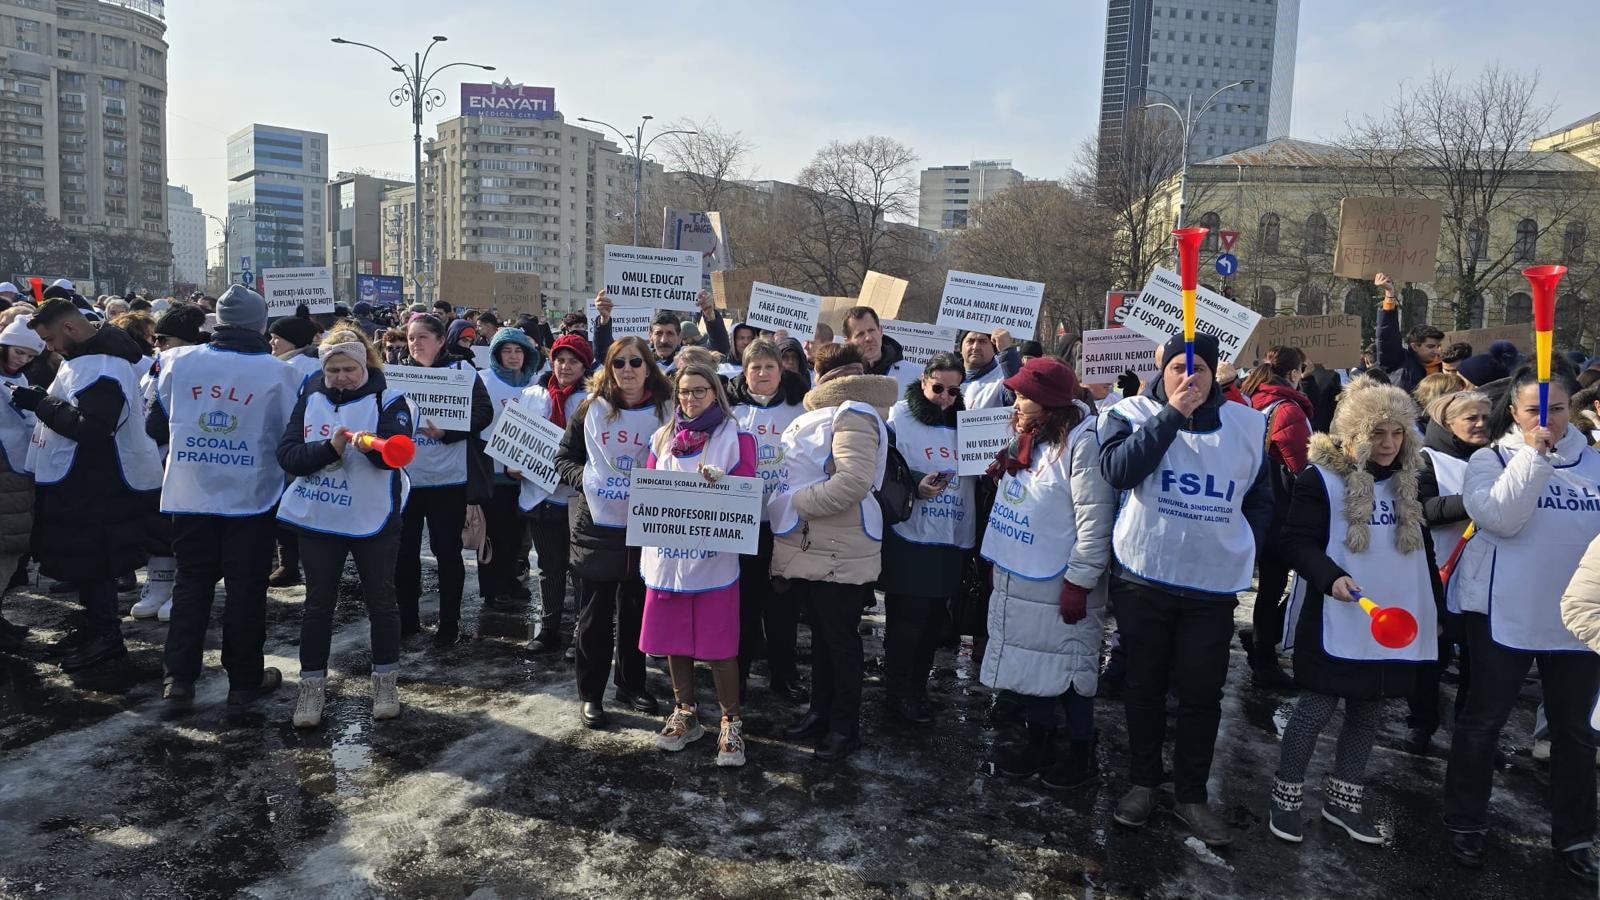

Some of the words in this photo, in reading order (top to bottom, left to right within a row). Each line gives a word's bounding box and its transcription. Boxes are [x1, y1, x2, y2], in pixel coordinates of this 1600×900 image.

[469, 96, 546, 111] ENAYATI
[1376, 234, 1402, 247] AER
[622, 271, 648, 283] OMUL
[650, 274, 684, 286] EDUCAT
[950, 276, 976, 285] SINDICATUL
[304, 288, 312, 296] CU
[313, 287, 326, 296] TOȚI,
[606, 284, 620, 295] NU
[622, 286, 639, 296] MAI
[641, 287, 662, 299] ESTE
[664, 288, 698, 302] CĂUTAT.
[1142, 292, 1160, 306] UN
[946, 296, 972, 308] ȘCOALA
[972, 299, 998, 311] MOARE
[1000, 302, 1008, 313] ÎN
[1010, 306, 1034, 318] NEVOI,
[1124, 296, 1136, 306] 50
[1202, 298, 1230, 314] PRAHOVEI
[758, 301, 776, 312] FĂRĂ
[776, 306, 808, 322] EDUCAȚIE,
[942, 308, 955, 316] VOI
[956, 308, 965, 318] VĂ
[966, 312, 990, 324] BATEȚI
[991, 316, 1006, 325] JOC
[1006, 318, 1016, 326] DE
[1016, 320, 1033, 330] NOI.
[1114, 306, 1130, 323] S
[749, 312, 773, 324] MOARE
[774, 318, 792, 328] ORICE
[793, 322, 814, 334] NAȚIE.
[1132, 306, 1142, 318] E
[1140, 310, 1166, 330] UȘOR
[1165, 326, 1180, 336] DE
[1086, 352, 1123, 362] SALARIUL
[1124, 350, 1156, 360] NEMOTI
[1086, 366, 1096, 375] PE
[1097, 365, 1123, 374] TINERI
[1125, 364, 1136, 372] LA
[1138, 363, 1159, 372] ALUN
[192, 385, 254, 406] FSLI
[404, 392, 428, 404] ANȚII
[429, 394, 470, 408] REPETENȚI
[420, 406, 468, 421] COMPETENȚI.
[962, 414, 992, 424] SINDICATUL
[304, 424, 330, 438] FS
[500, 420, 521, 440] NOI
[758, 424, 780, 435] SL
[186, 436, 248, 452] SCOALA
[601, 430, 643, 446] FSL
[966, 440, 976, 448] NU
[978, 438, 998, 448] VREM
[177, 451, 254, 466] PRAHOVEI
[491, 434, 510, 454] VOI
[508, 445, 524, 462] NE
[522, 453, 558, 485] FURAȚI.
[924, 446, 958, 461] FSL
[962, 452, 982, 462] VREM
[984, 452, 998, 460] DRE
[606, 477, 630, 488] SCO
[636, 478, 672, 486] SINDICATUL
[674, 480, 697, 488] ȘCOALA
[698, 482, 730, 490] PRAHOVEI
[1162, 470, 1236, 502] FSLI
[294, 486, 352, 507] PRAHOVEI
[597, 488, 630, 500] PRAH
[1158, 496, 1188, 510] UNIUNEA
[1190, 504, 1233, 514] SINDICATELOR
[1537, 496, 1600, 512] IALOMI
[632, 502, 659, 517] CÂND
[662, 506, 718, 522] PROFESORII
[720, 512, 756, 526] DISPAR,
[993, 502, 1030, 528] SCOALA
[1158, 506, 1202, 520] INVATAMANT
[1204, 514, 1230, 524] IALOMITA
[642, 522, 686, 535] VIITORUL
[689, 526, 711, 537] ESTE
[712, 528, 744, 540] AMAR.
[988, 516, 1034, 545] PRAHOVEI
